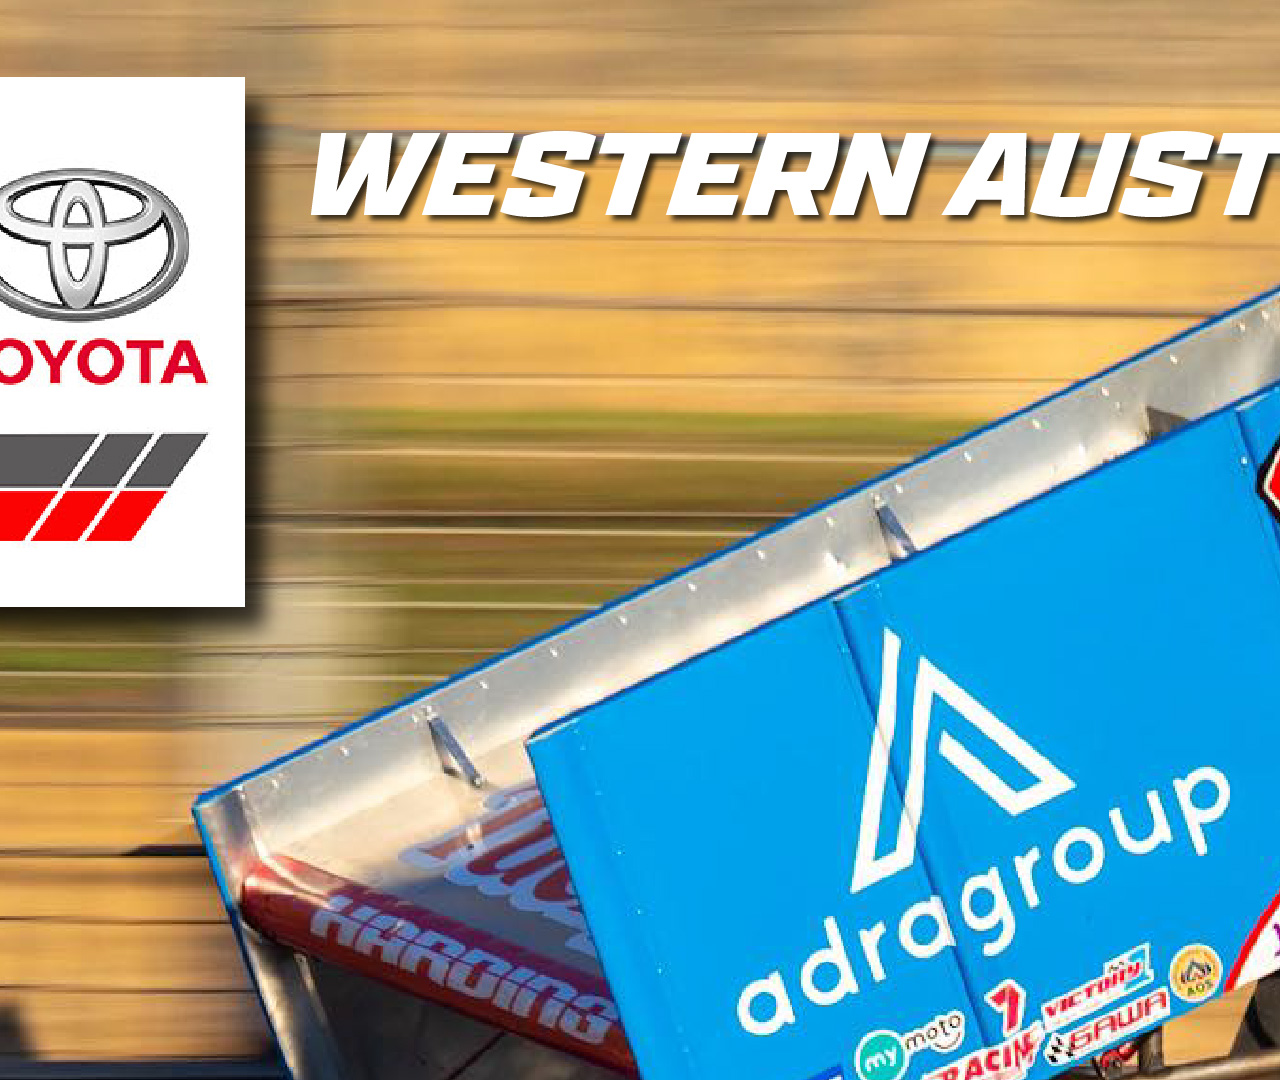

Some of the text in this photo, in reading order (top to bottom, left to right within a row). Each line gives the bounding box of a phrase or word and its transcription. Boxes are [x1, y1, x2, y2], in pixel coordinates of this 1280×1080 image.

[310, 894, 619, 1045] HARDING
[736, 766, 1230, 1035] adragroup
[864, 1014, 962, 1074] my moto
